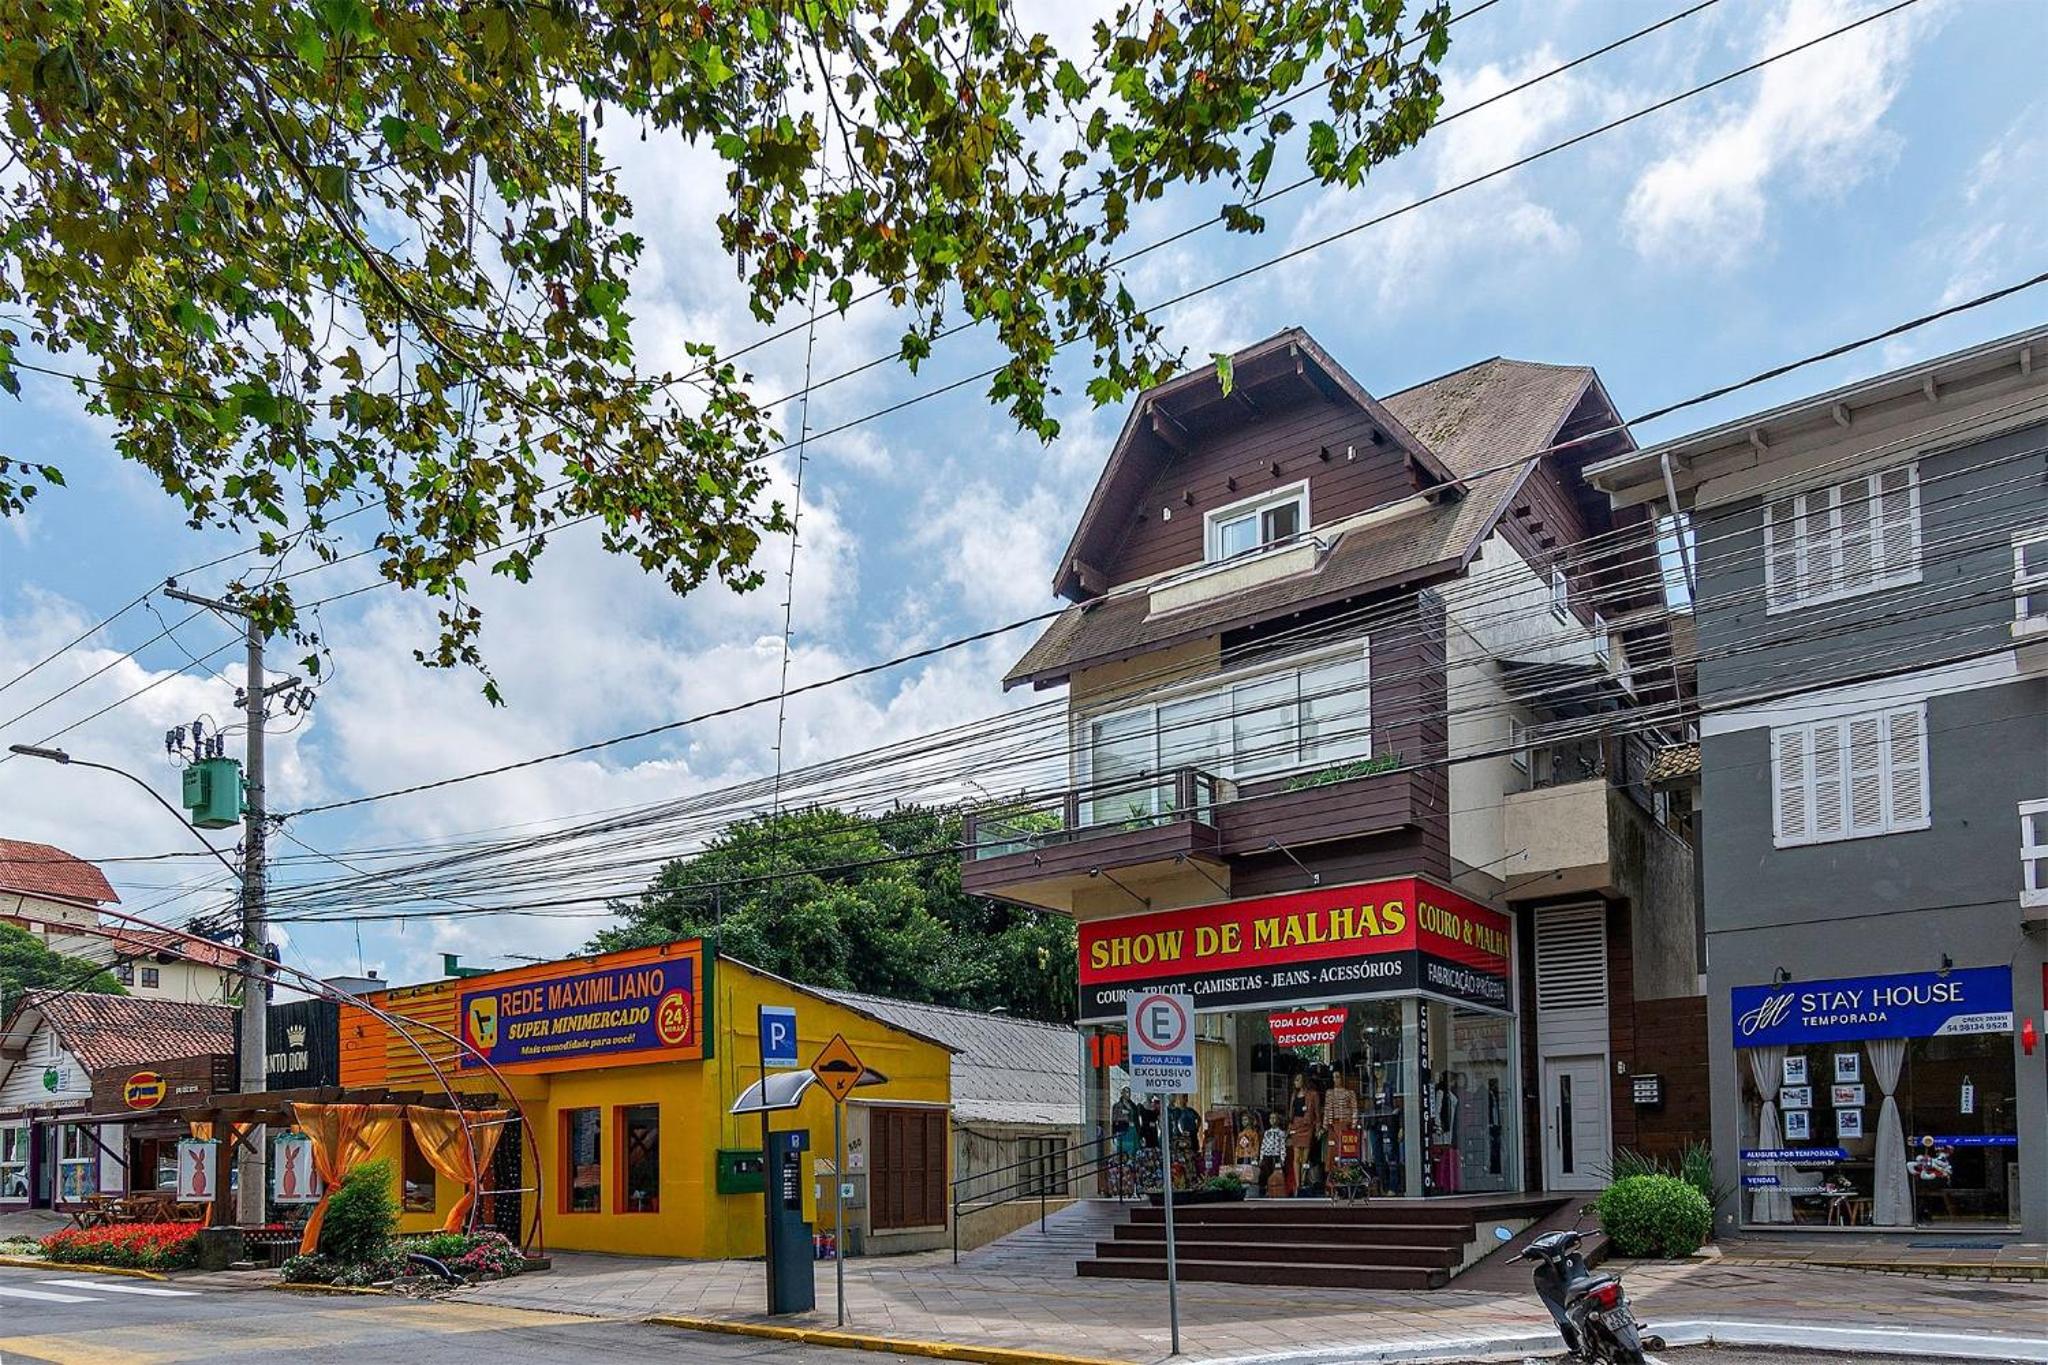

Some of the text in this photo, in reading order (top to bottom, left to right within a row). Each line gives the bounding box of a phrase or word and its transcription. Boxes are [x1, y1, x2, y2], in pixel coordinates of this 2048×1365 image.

[1418, 902, 1461, 940] COURO
[1463, 919, 1473, 946] &
[1091, 901, 1407, 969] SHOW DE MALHAS
[1194, 975, 1262, 995] CAMISETAS
[1270, 970, 1310, 988] JEANS
[1319, 960, 1402, 983] ACESSÓRIOS
[1427, 962, 1476, 996] FABRICAÇÃO
[501, 968, 664, 1018] REDE MAXIMILIANO
[1801, 982, 1965, 1013] STAY HOUSE
[508, 1006, 650, 1040] SUPER MINIMERCADO
[664, 1008, 682, 1026] 24
[1152, 1007, 1171, 1039] E
[1269, 1014, 1345, 1029] TODA LOJA COM
[1802, 1012, 1888, 1026] TEMPORADA
[521, 1045, 541, 1055] Mais
[590, 1039, 611, 1049] para
[1278, 1031, 1336, 1044] DESCONTOS
[289, 1051, 308, 1072] DOM
[1141, 1055, 1183, 1065] ZONA AZUL
[1134, 1068, 1192, 1078] EXCLUSIVO
[1146, 1079, 1182, 1088] MOTOS
